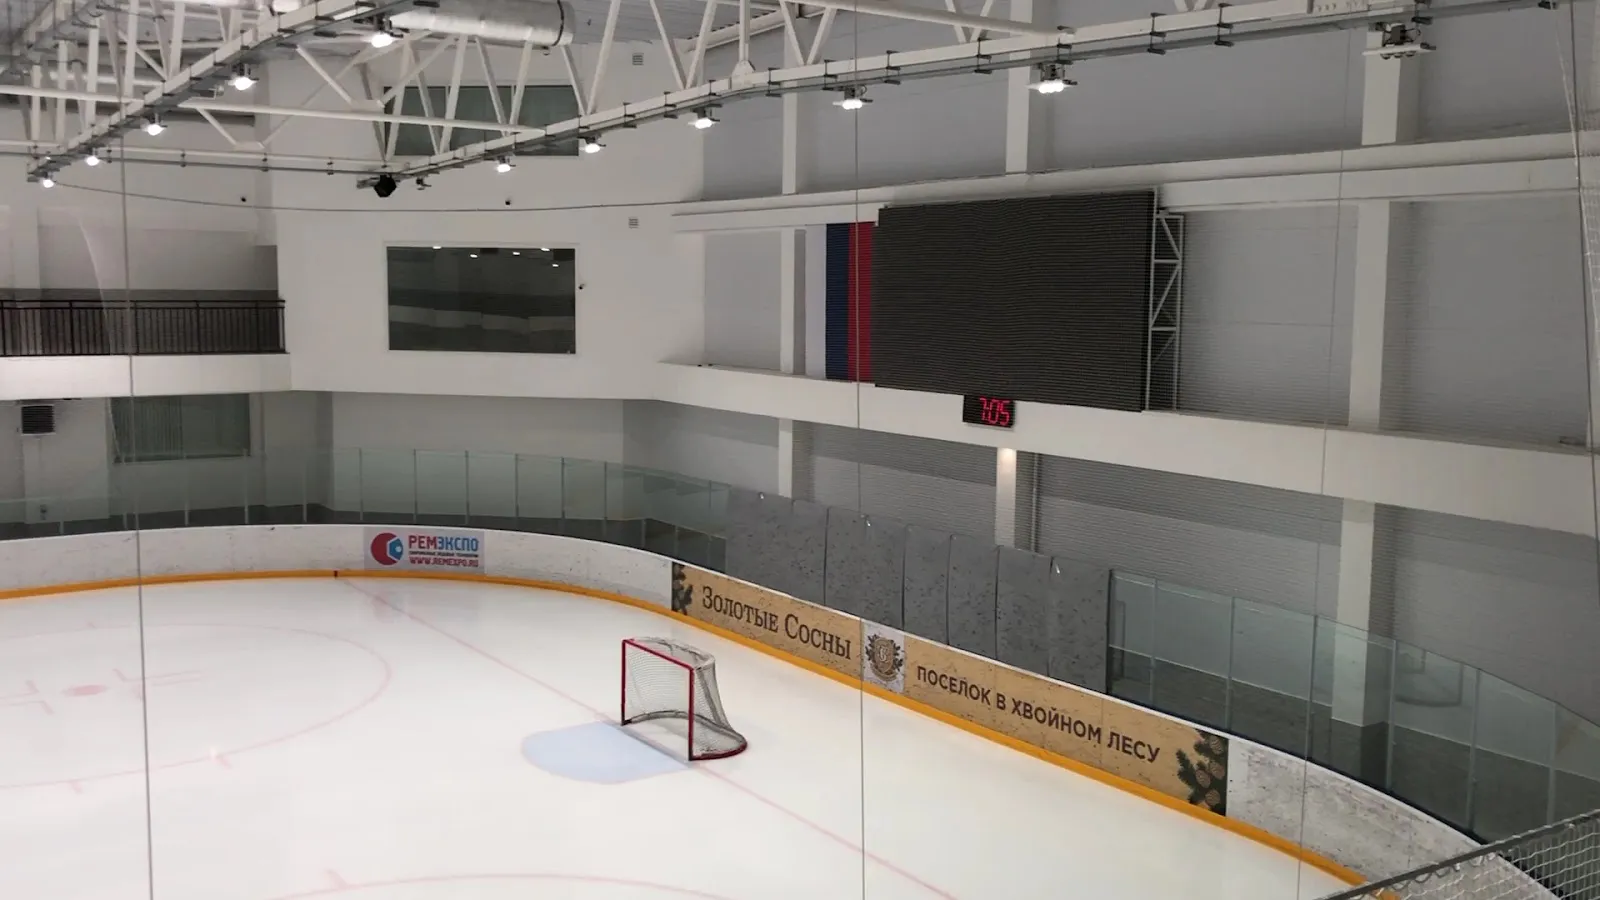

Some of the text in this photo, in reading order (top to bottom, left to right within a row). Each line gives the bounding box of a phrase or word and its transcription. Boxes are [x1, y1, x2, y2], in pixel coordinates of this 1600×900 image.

[408, 535, 479, 551] РЕМЭКСПО
[408, 556, 479, 567] WWW.REMEXPO.RU
[917, 666, 1160, 763] ПОСЕЛОК В ХВОЙНОМ ЛЕСУ
